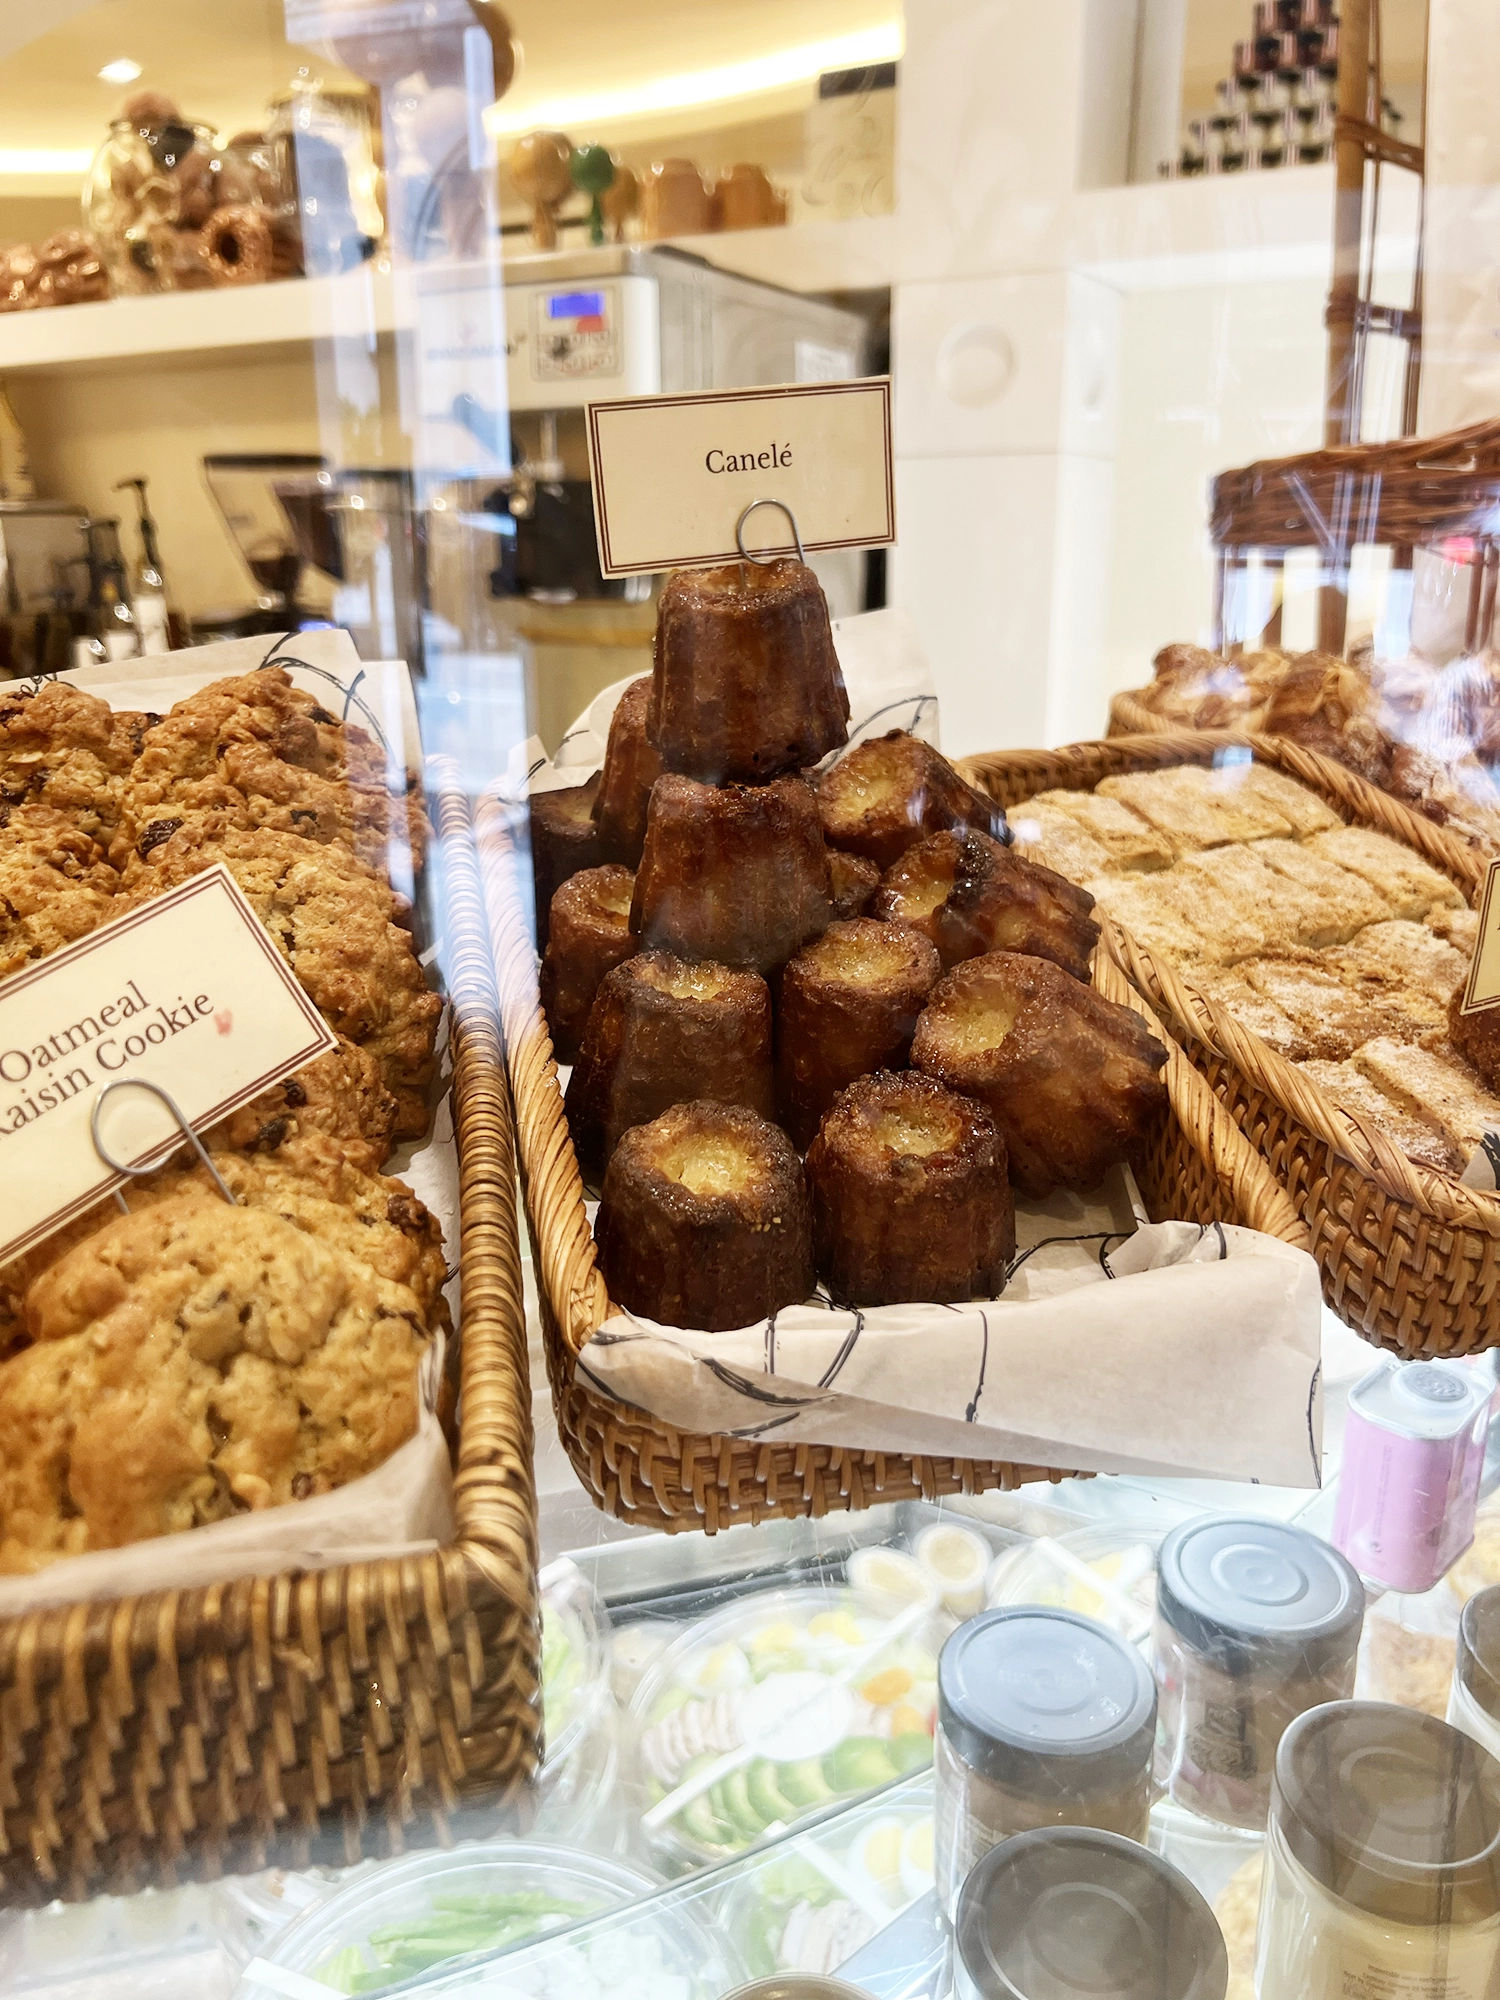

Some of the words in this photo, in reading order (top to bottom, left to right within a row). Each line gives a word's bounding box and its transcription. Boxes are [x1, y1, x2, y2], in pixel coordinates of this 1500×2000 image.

[705, 443, 793, 474] Canelé
[0, 979, 151, 1083] Oatmeal
[95, 993, 214, 1071] Cookie
